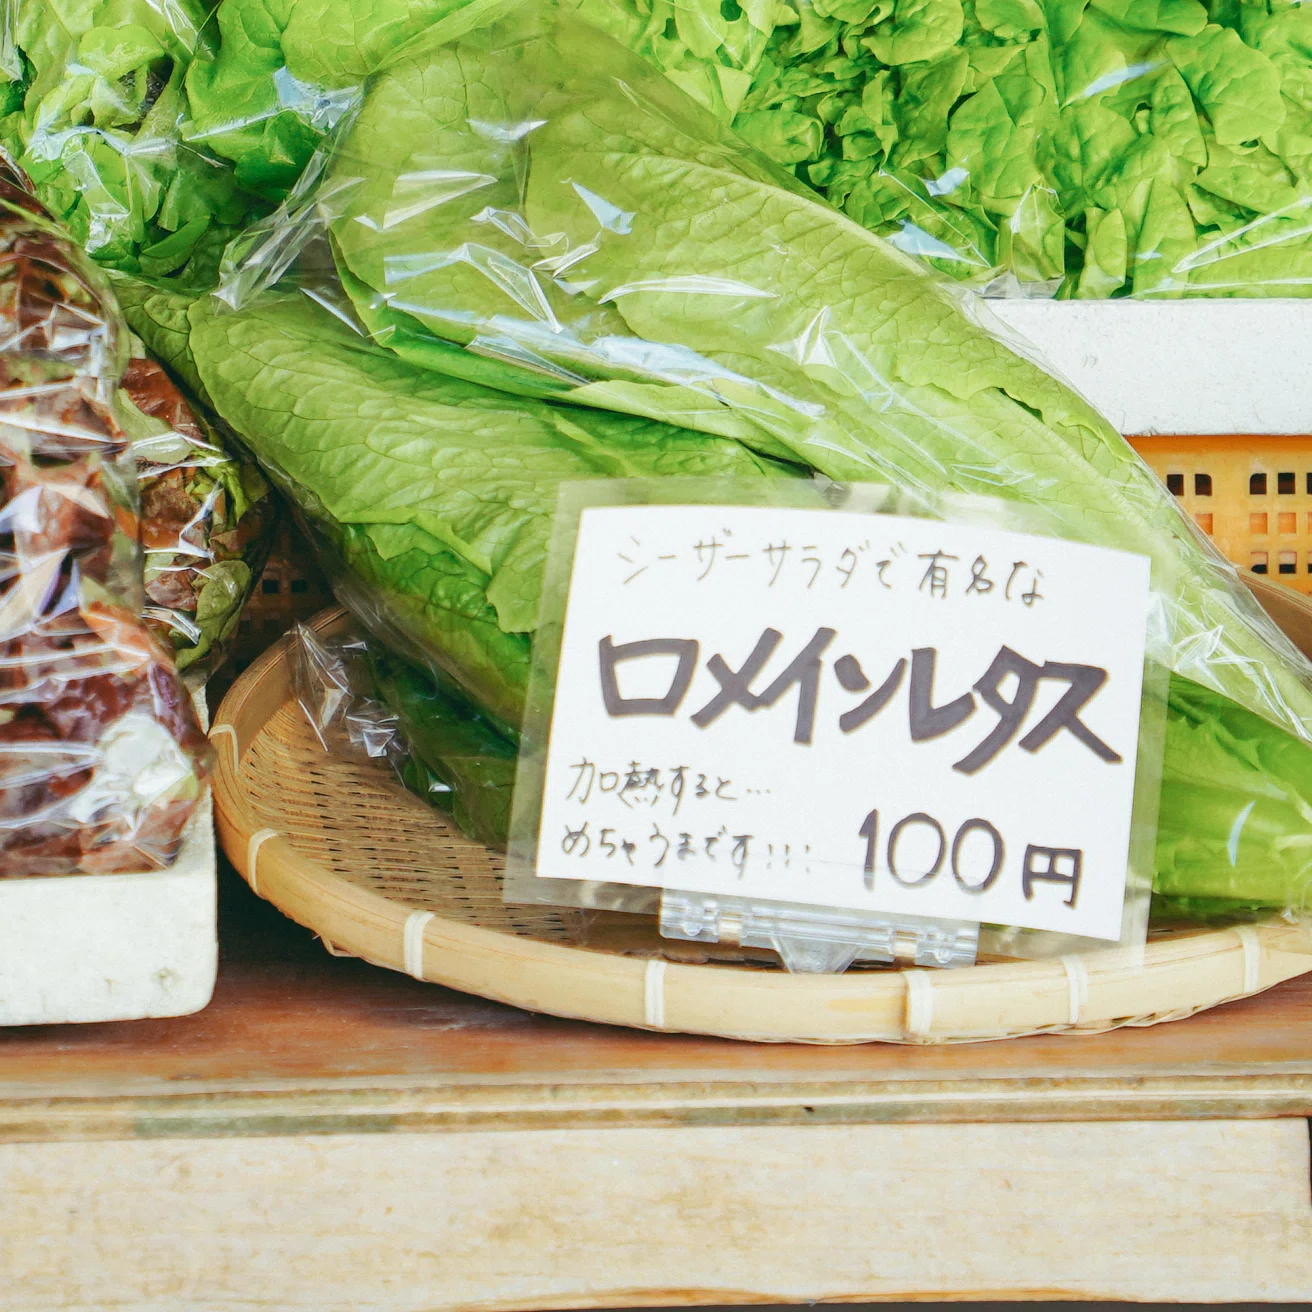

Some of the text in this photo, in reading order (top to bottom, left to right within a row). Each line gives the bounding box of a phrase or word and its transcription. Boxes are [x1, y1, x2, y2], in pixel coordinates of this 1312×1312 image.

[615, 526, 1046, 607] シーザーサラダで有名な
[598, 626, 1123, 776] ロメインレタス
[858, 809, 1084, 909] 100円
